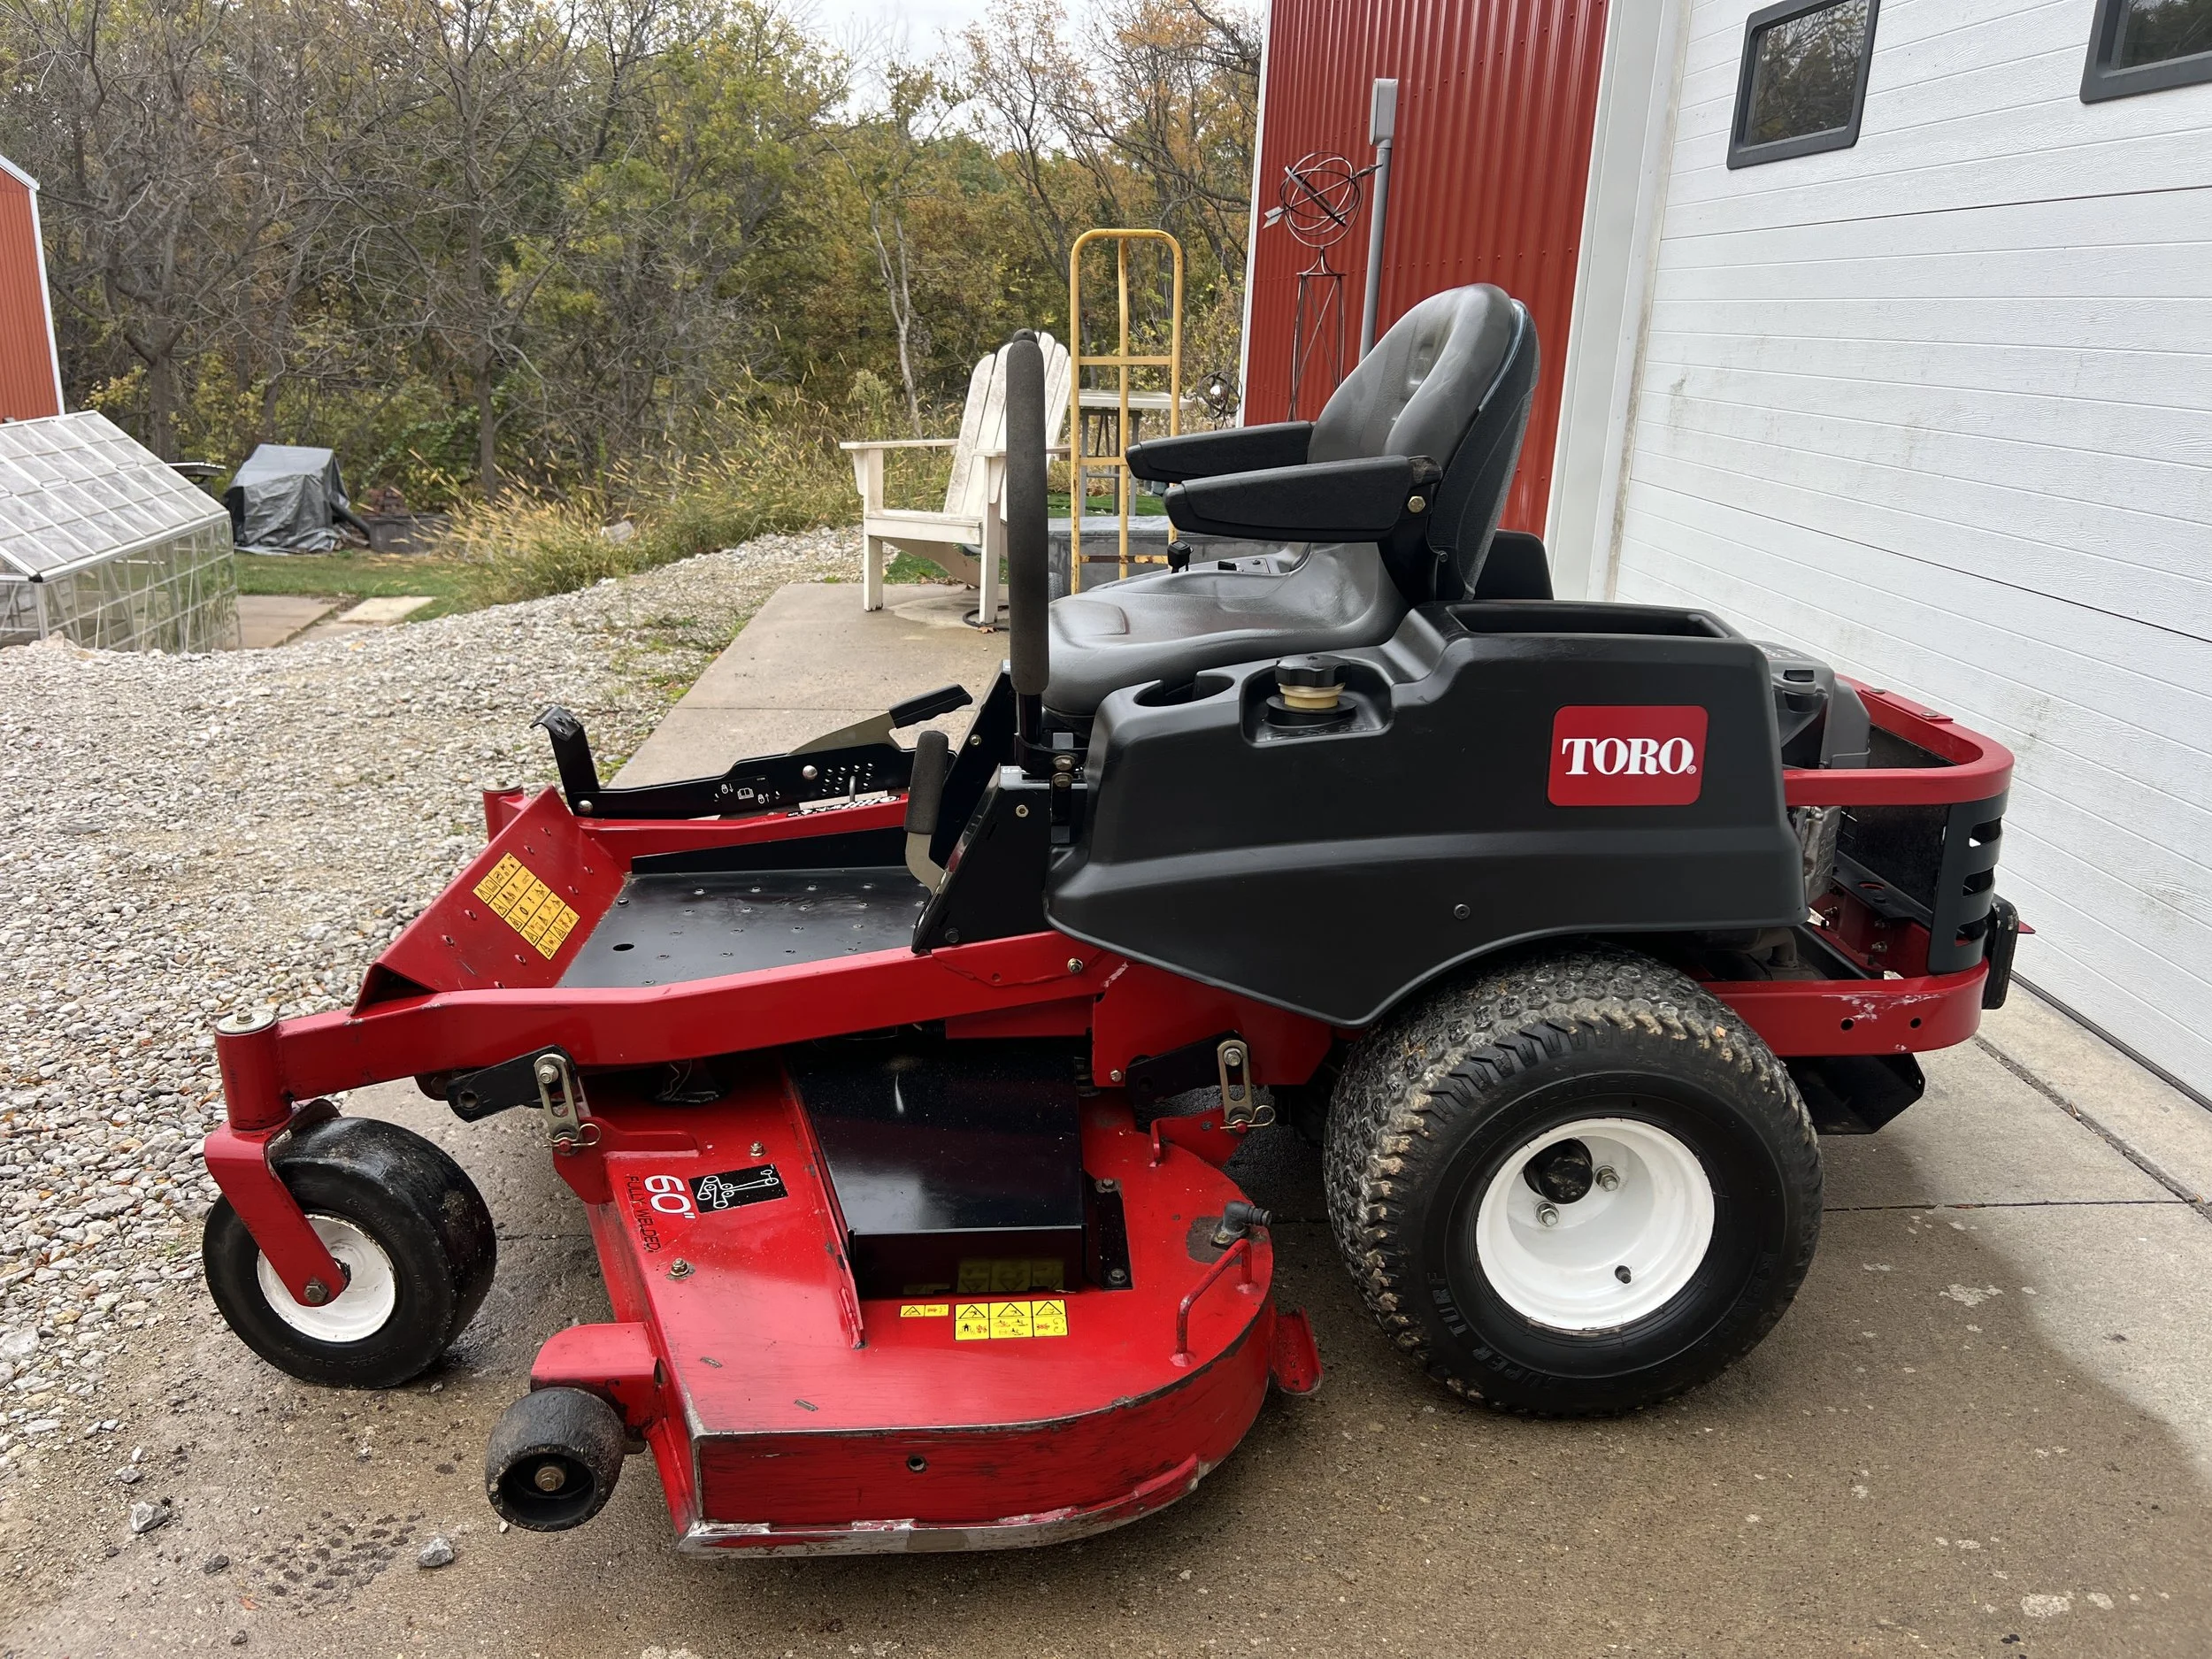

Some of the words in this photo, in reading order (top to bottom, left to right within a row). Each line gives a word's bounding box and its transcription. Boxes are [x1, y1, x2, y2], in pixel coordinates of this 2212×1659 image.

[626, 1176, 644, 1207] FULLY
[637, 1208, 661, 1253] WELDED
[1426, 1271, 1468, 1338] TURF
[1472, 1346, 1561, 1389] SUPER
